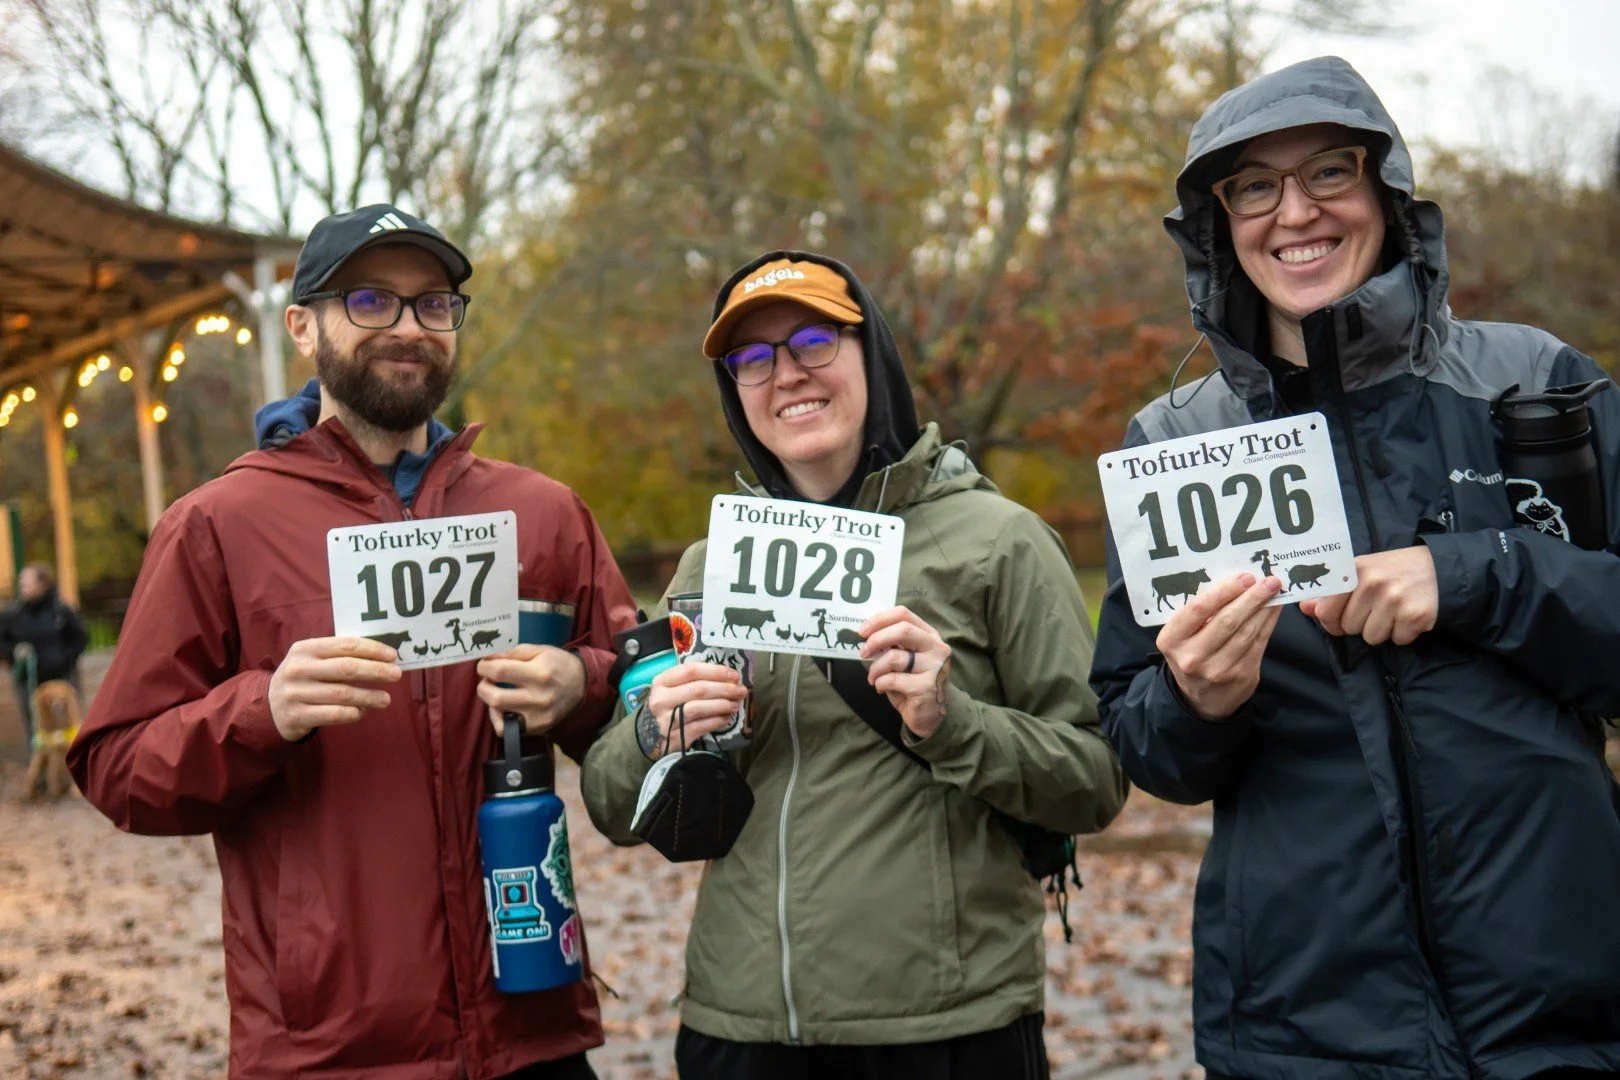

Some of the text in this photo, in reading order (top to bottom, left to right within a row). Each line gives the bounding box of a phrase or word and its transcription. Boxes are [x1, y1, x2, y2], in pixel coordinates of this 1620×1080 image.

[743, 267, 806, 294] bagels
[1123, 428, 1304, 480] Tofurky Trot
[1243, 448, 1307, 465] Chase Compassion
[1464, 468, 1504, 485] Colum
[733, 503, 883, 538] Tofurky Trot
[1138, 463, 1315, 561] 1026
[349, 523, 497, 552] Tofurky Trot
[1273, 542, 1341, 562] Northwest VEG
[730, 536, 875, 604] 1028
[357, 551, 495, 622] 1027
[463, 613, 511, 627] Northwest VEG
